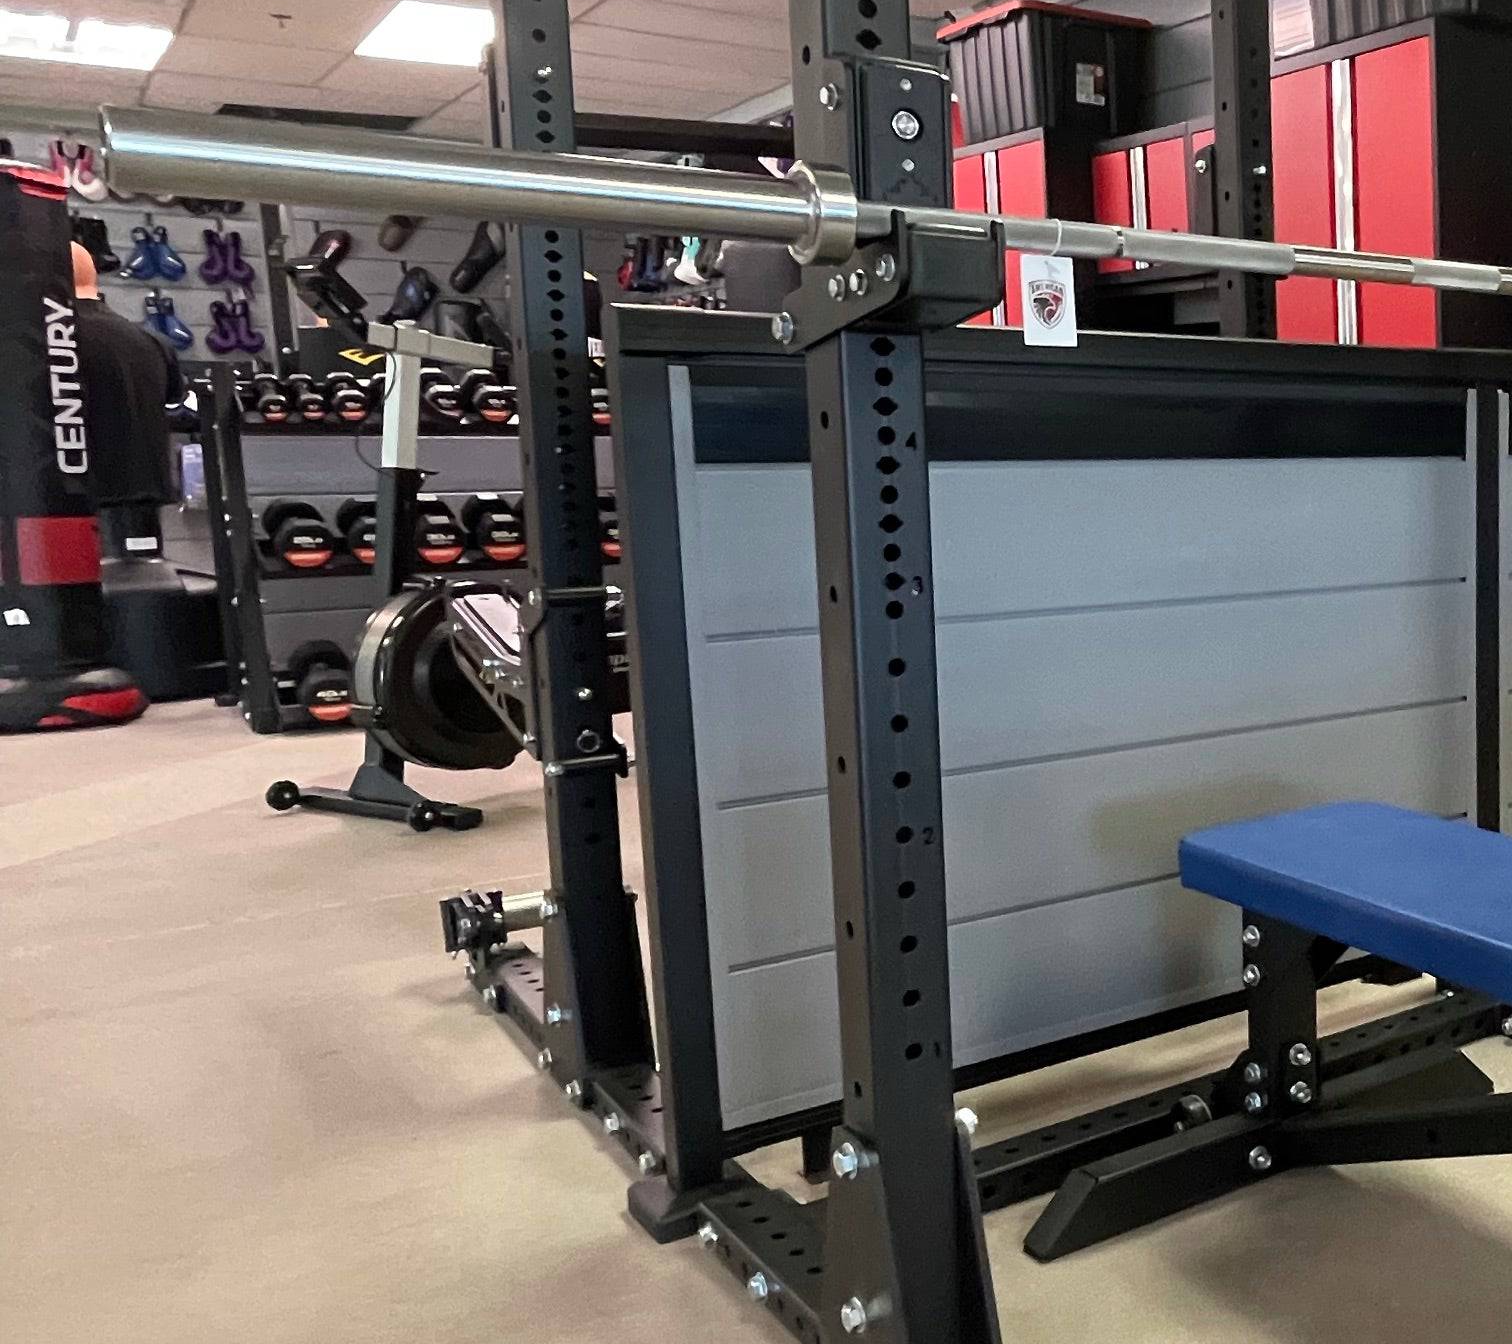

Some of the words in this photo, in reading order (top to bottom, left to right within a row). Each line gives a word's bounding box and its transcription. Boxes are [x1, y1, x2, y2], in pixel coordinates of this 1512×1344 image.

[43, 297, 89, 475] CENTURY
[904, 431, 917, 452] 4
[922, 826, 935, 846] 2
